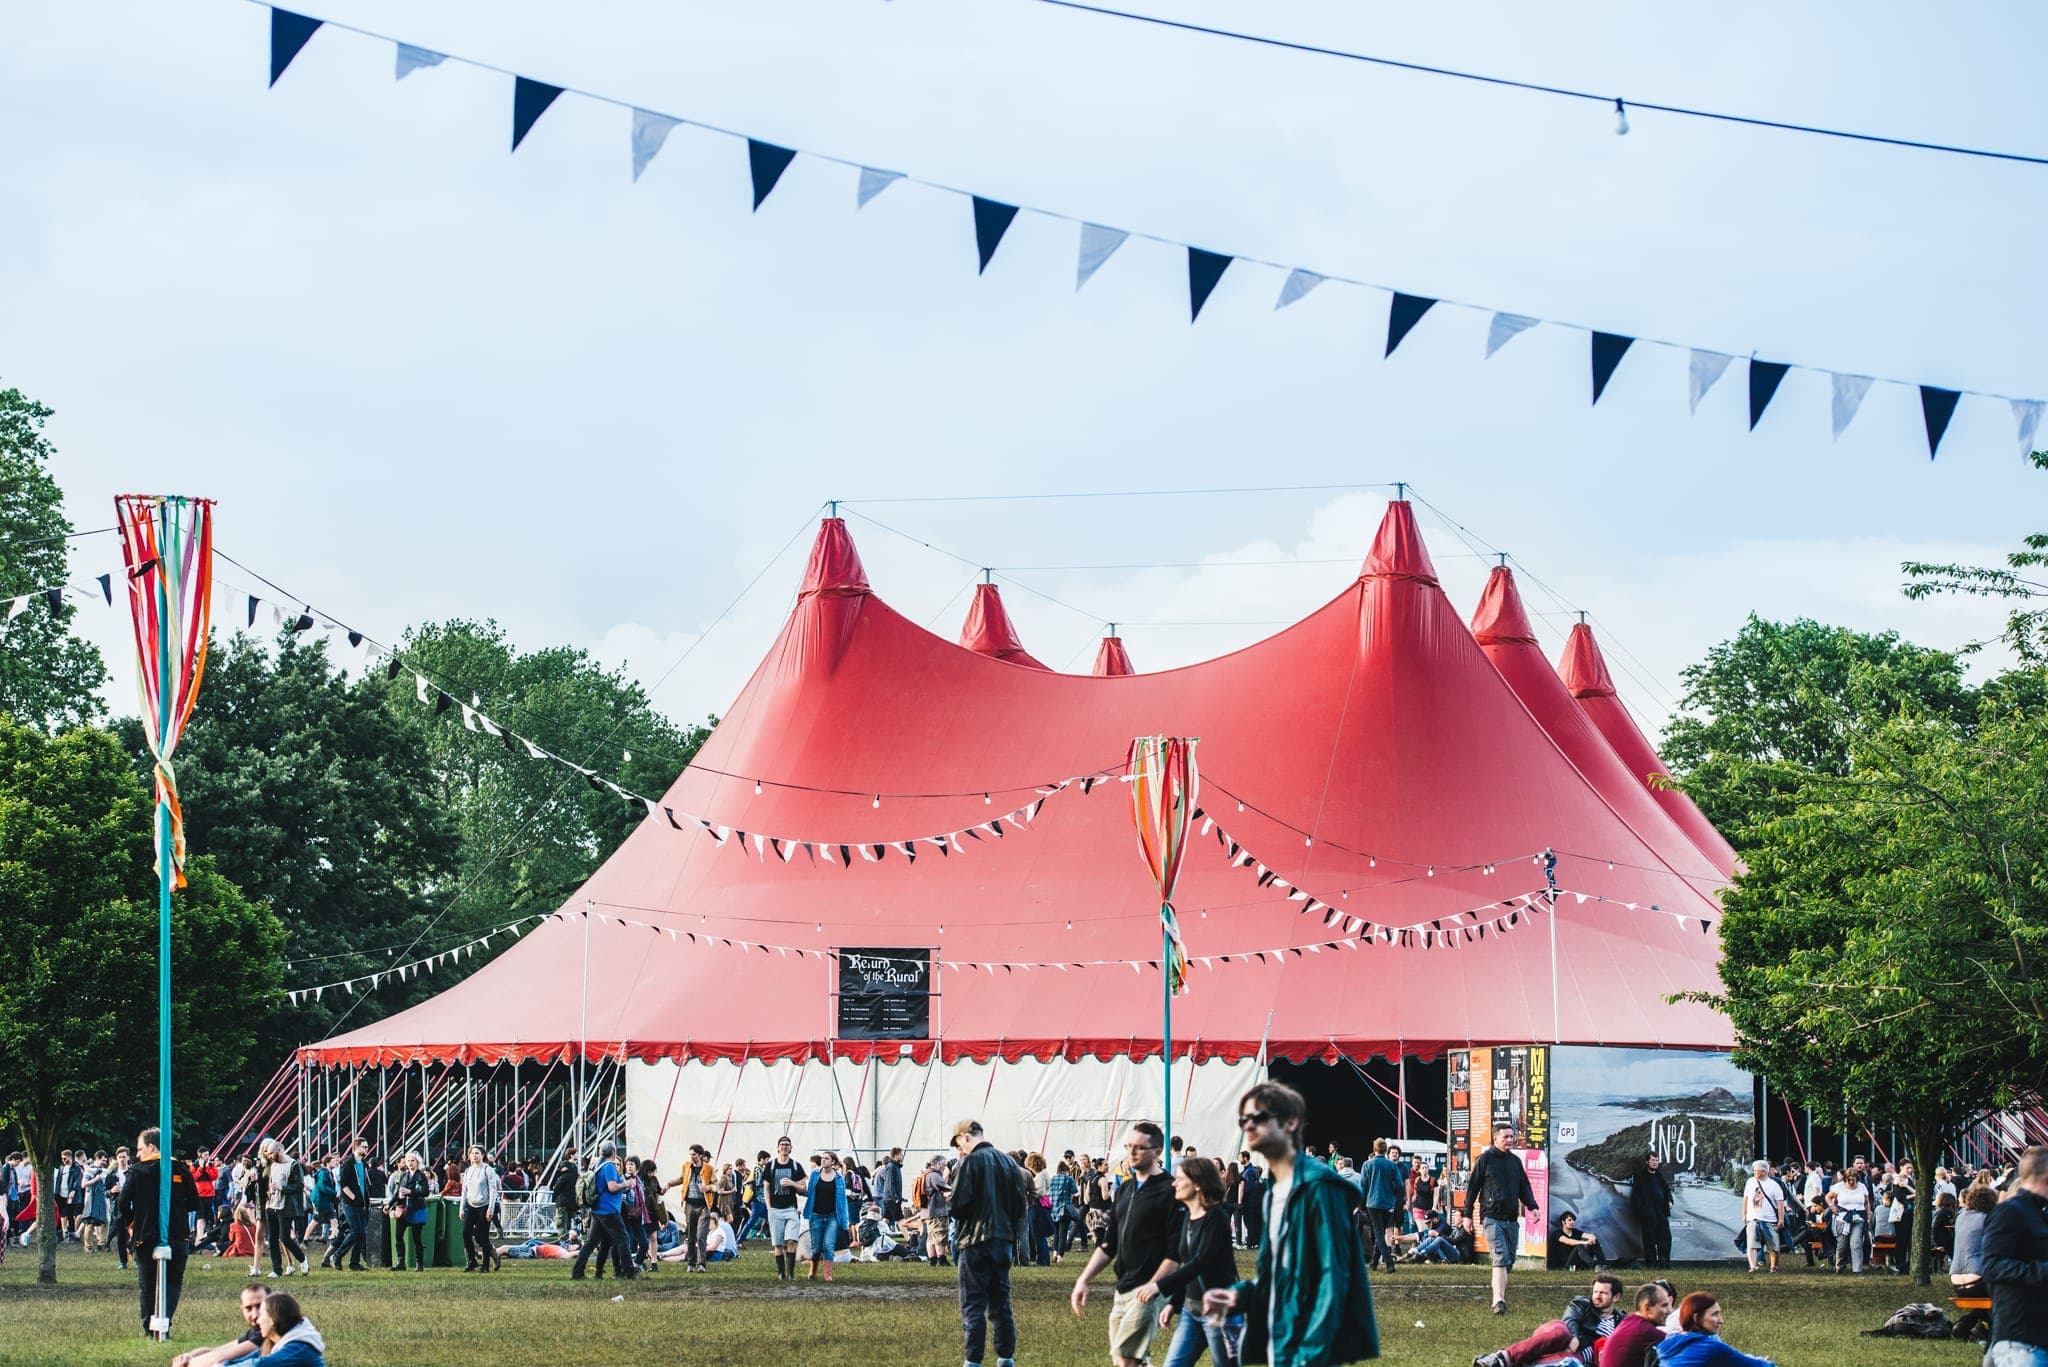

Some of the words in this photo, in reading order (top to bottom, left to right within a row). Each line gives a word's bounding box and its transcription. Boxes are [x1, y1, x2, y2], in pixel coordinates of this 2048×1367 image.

[863, 970, 872, 984] of
[872, 970, 884, 984] the
[884, 968, 919, 987] Rural
